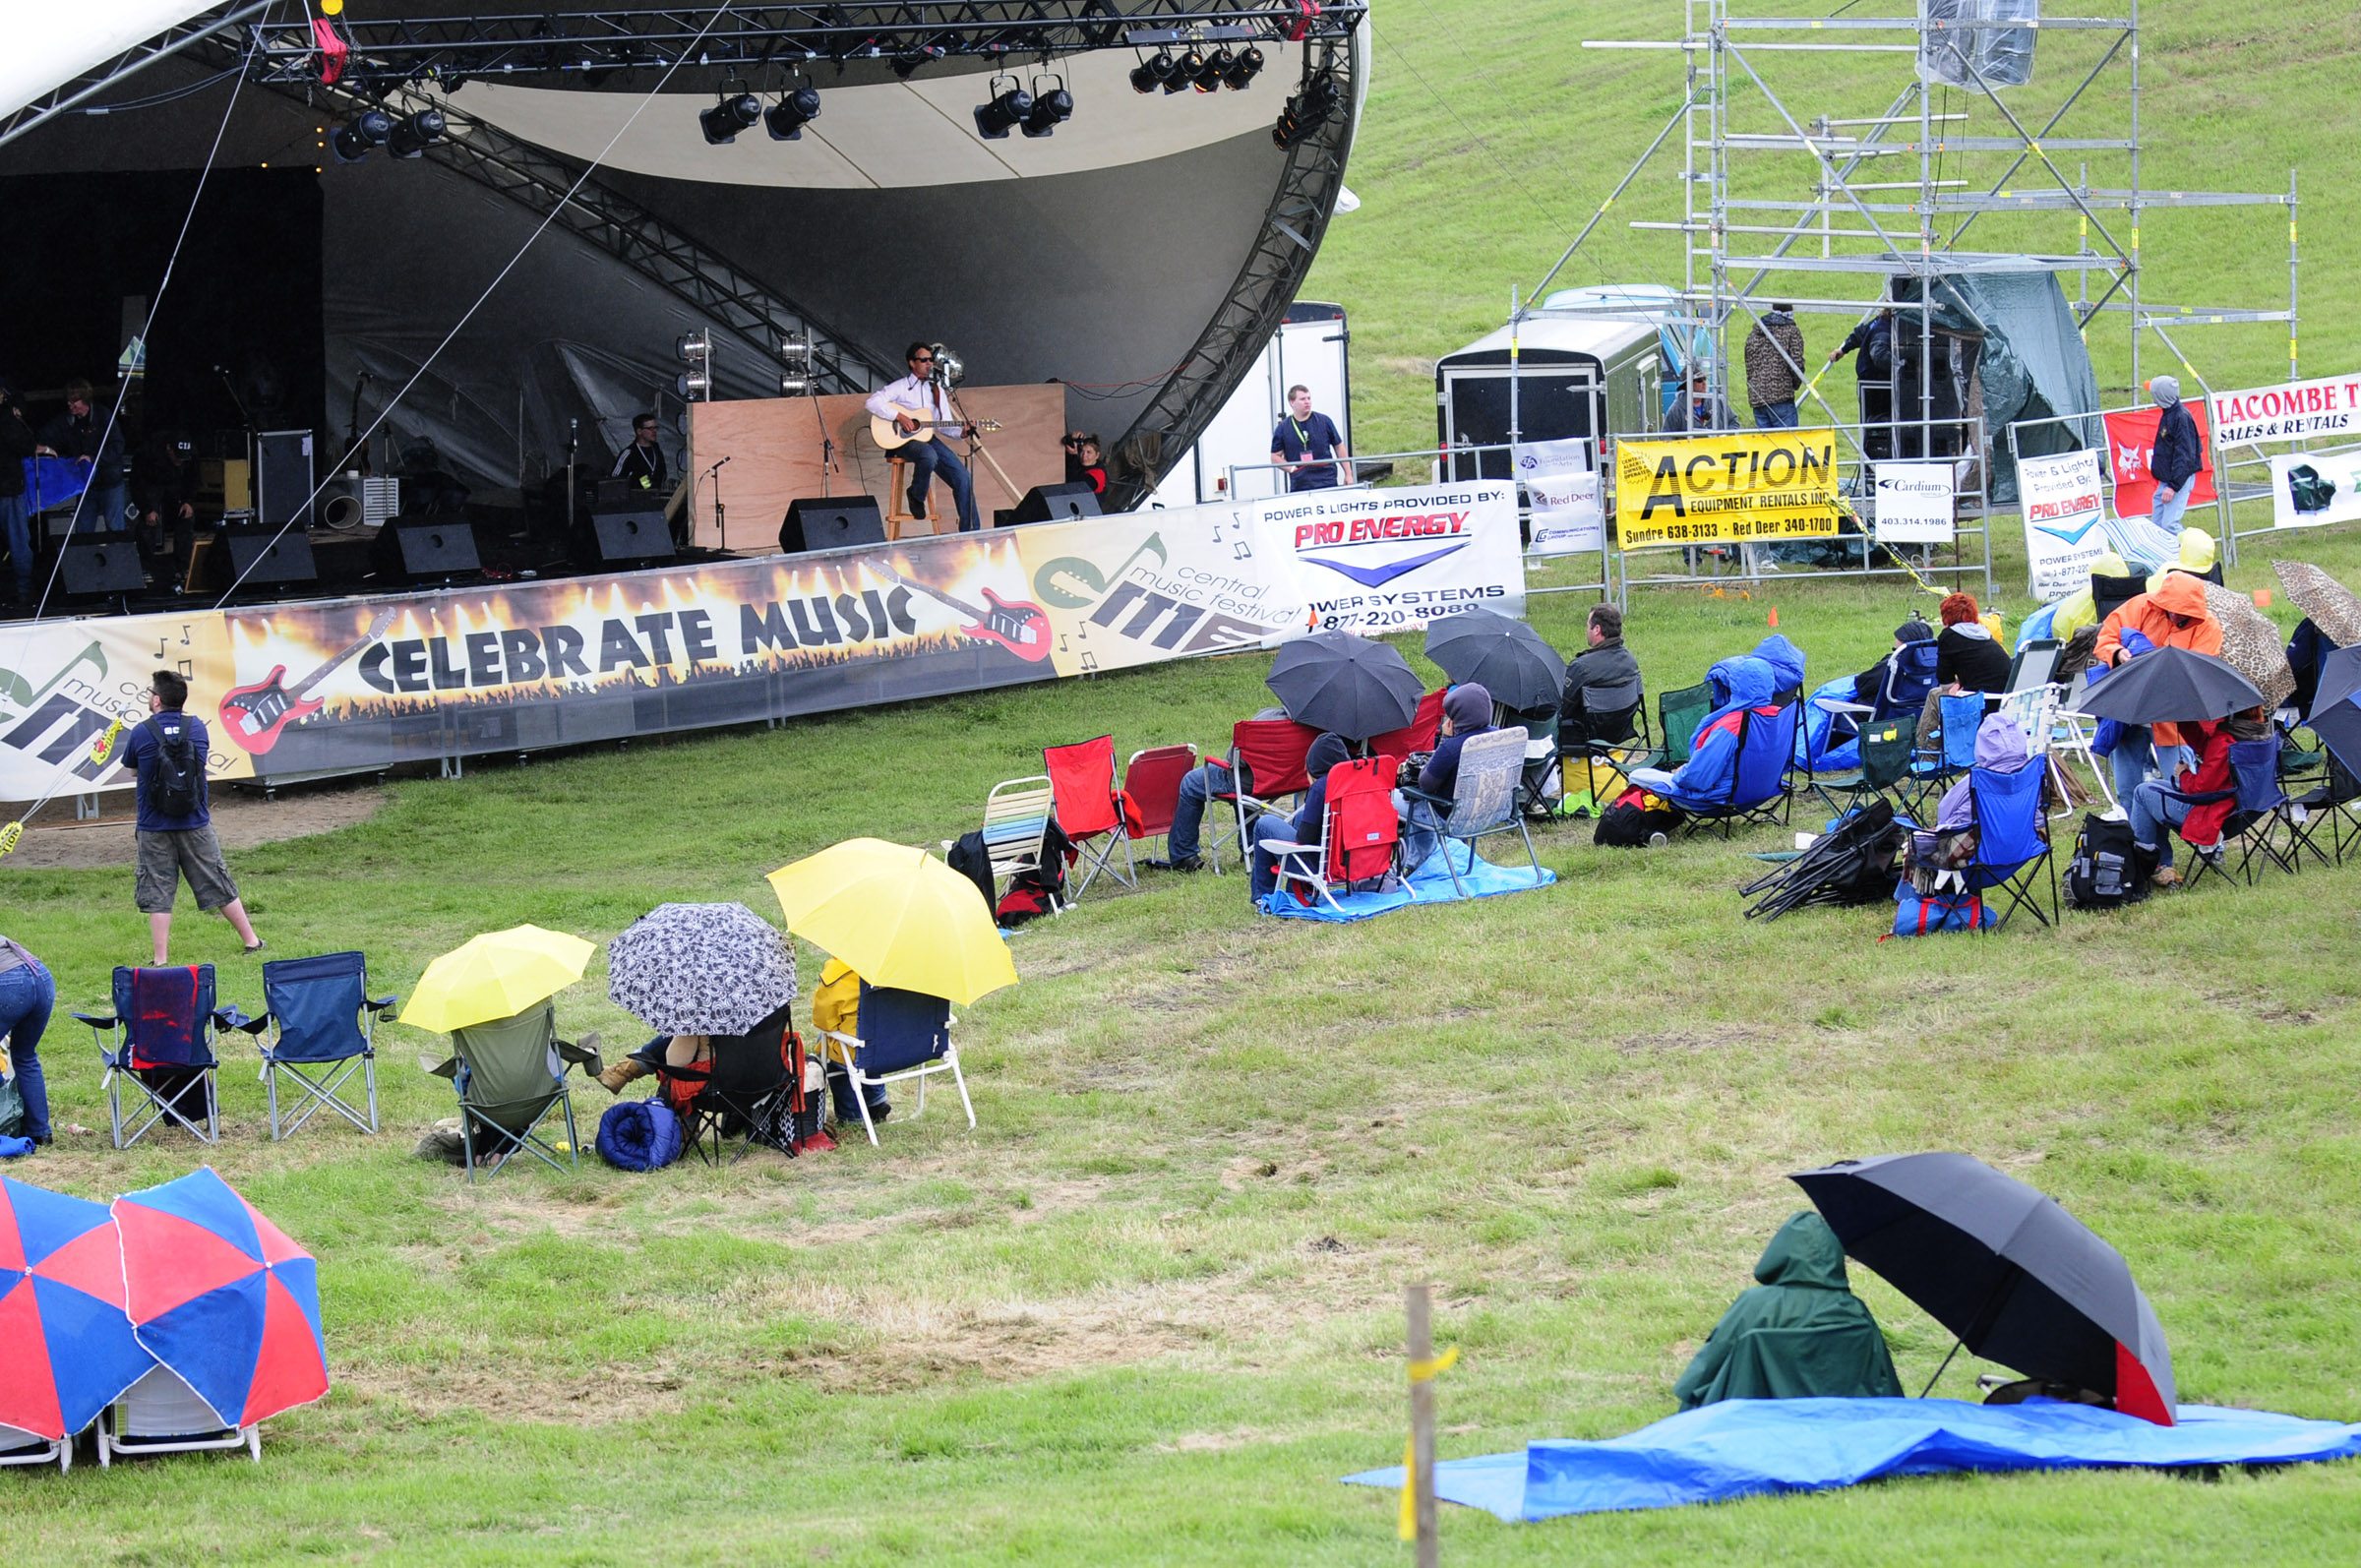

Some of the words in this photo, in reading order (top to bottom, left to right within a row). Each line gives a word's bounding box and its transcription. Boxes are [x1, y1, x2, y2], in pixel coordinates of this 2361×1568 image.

[2215, 385, 2337, 424] LACOMBE
[2345, 383, 2361, 407] T
[2220, 424, 2263, 443] SALES
[2266, 422, 2277, 436] &
[2283, 413, 2348, 434] RENTALS
[2061, 457, 2094, 472] Lights
[1640, 445, 1832, 520] ACTION
[1895, 479, 1941, 492] Cardium
[1264, 507, 1312, 522] POWER
[1316, 505, 1325, 515] &
[1330, 501, 1378, 514] LIGHTS
[1383, 494, 1472, 510] PROVIDED
[1478, 490, 1505, 503] BY:
[1550, 495, 1570, 506] Red
[1571, 492, 1595, 503] Deer
[1690, 496, 1754, 513] EQUIPMENT
[1760, 494, 1807, 509] RENTALS
[2029, 501, 2059, 520] PRO
[1295, 521, 1345, 548] PRO
[1349, 511, 1471, 542] ENERGY
[1625, 528, 1664, 544] Sundre
[1667, 523, 1718, 539] 638-3133
[1732, 521, 1752, 536] Red
[1756, 520, 1781, 535] Deer
[1785, 517, 1832, 532] 340-1700
[1881, 517, 1947, 526] 403.314.1986
[2039, 554, 2072, 566] POWER
[1130, 566, 1201, 602] music
[1210, 592, 1302, 624] festival
[1178, 566, 1270, 600] central
[1368, 585, 1505, 606] SYSTEMS
[358, 608, 718, 694] CELEBRATE
[739, 584, 917, 655] MUSIC
